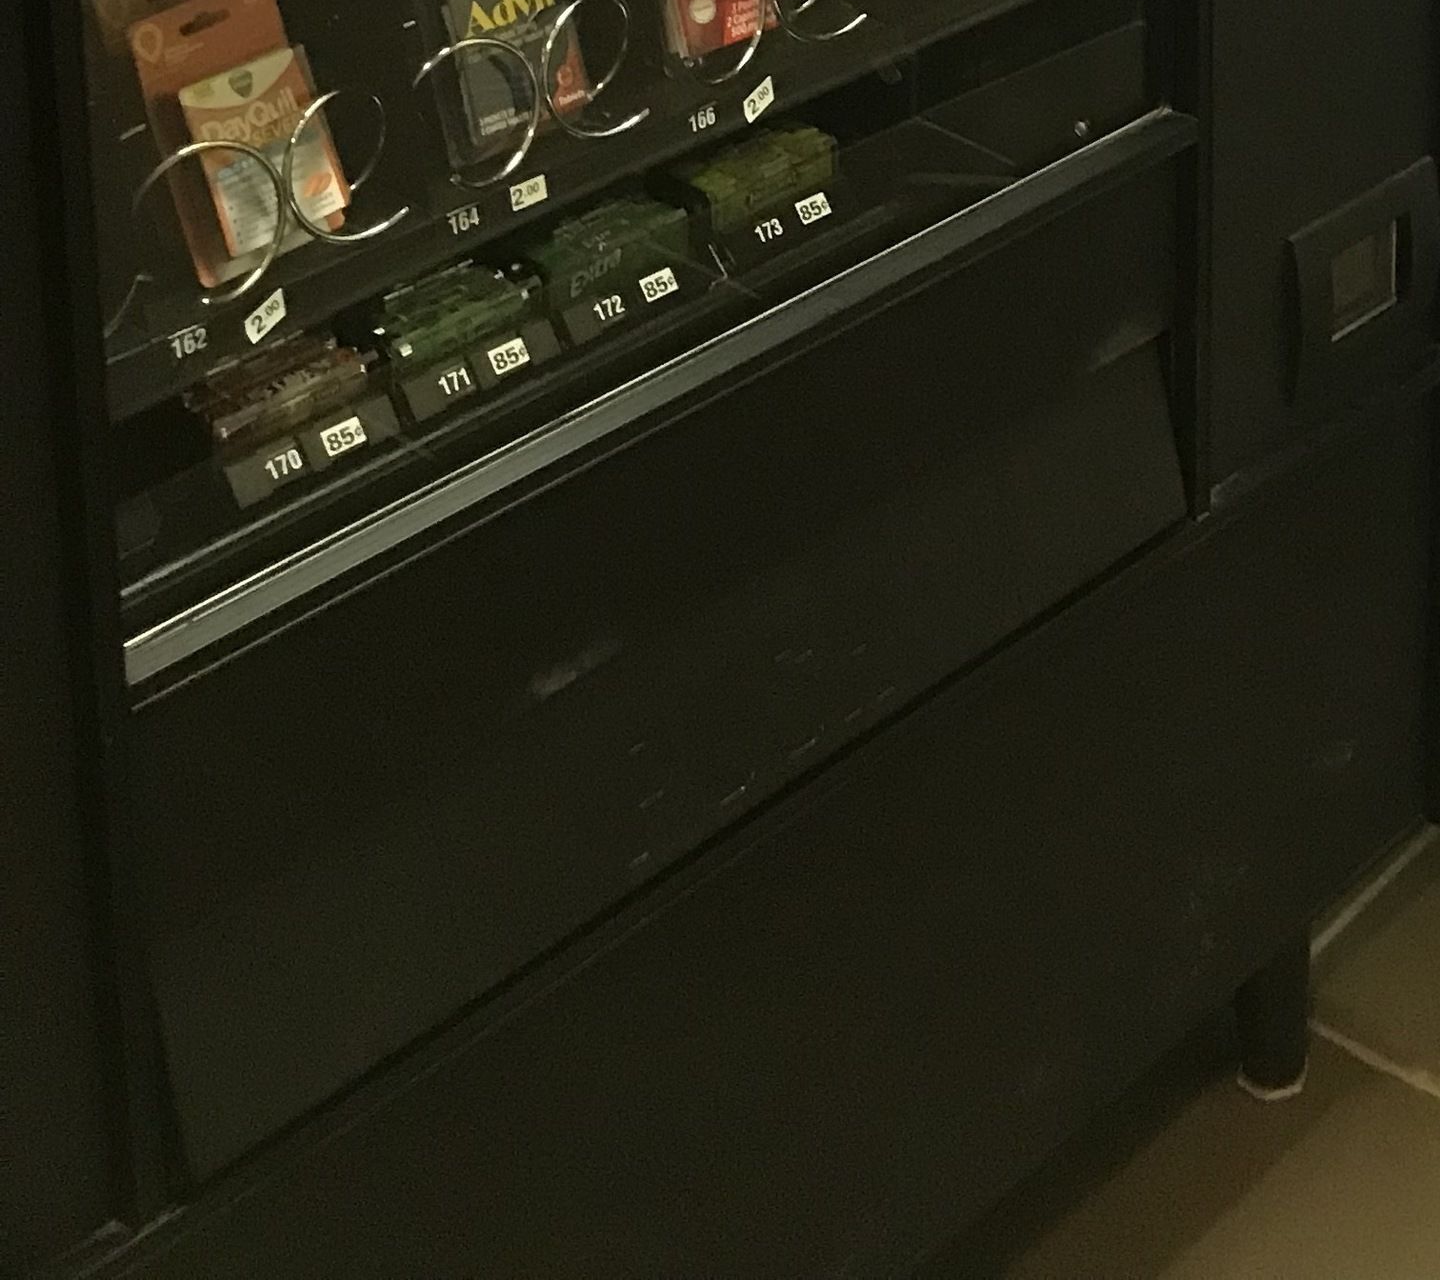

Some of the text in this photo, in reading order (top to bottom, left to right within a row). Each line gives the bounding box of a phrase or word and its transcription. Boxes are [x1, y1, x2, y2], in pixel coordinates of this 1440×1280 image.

[688, 106, 717, 133] 166
[448, 206, 481, 235] 164
[754, 217, 784, 243] 173
[592, 294, 626, 321] 172
[171, 327, 208, 359] 162
[437, 366, 472, 396] 171
[264, 448, 303, 480] 170
